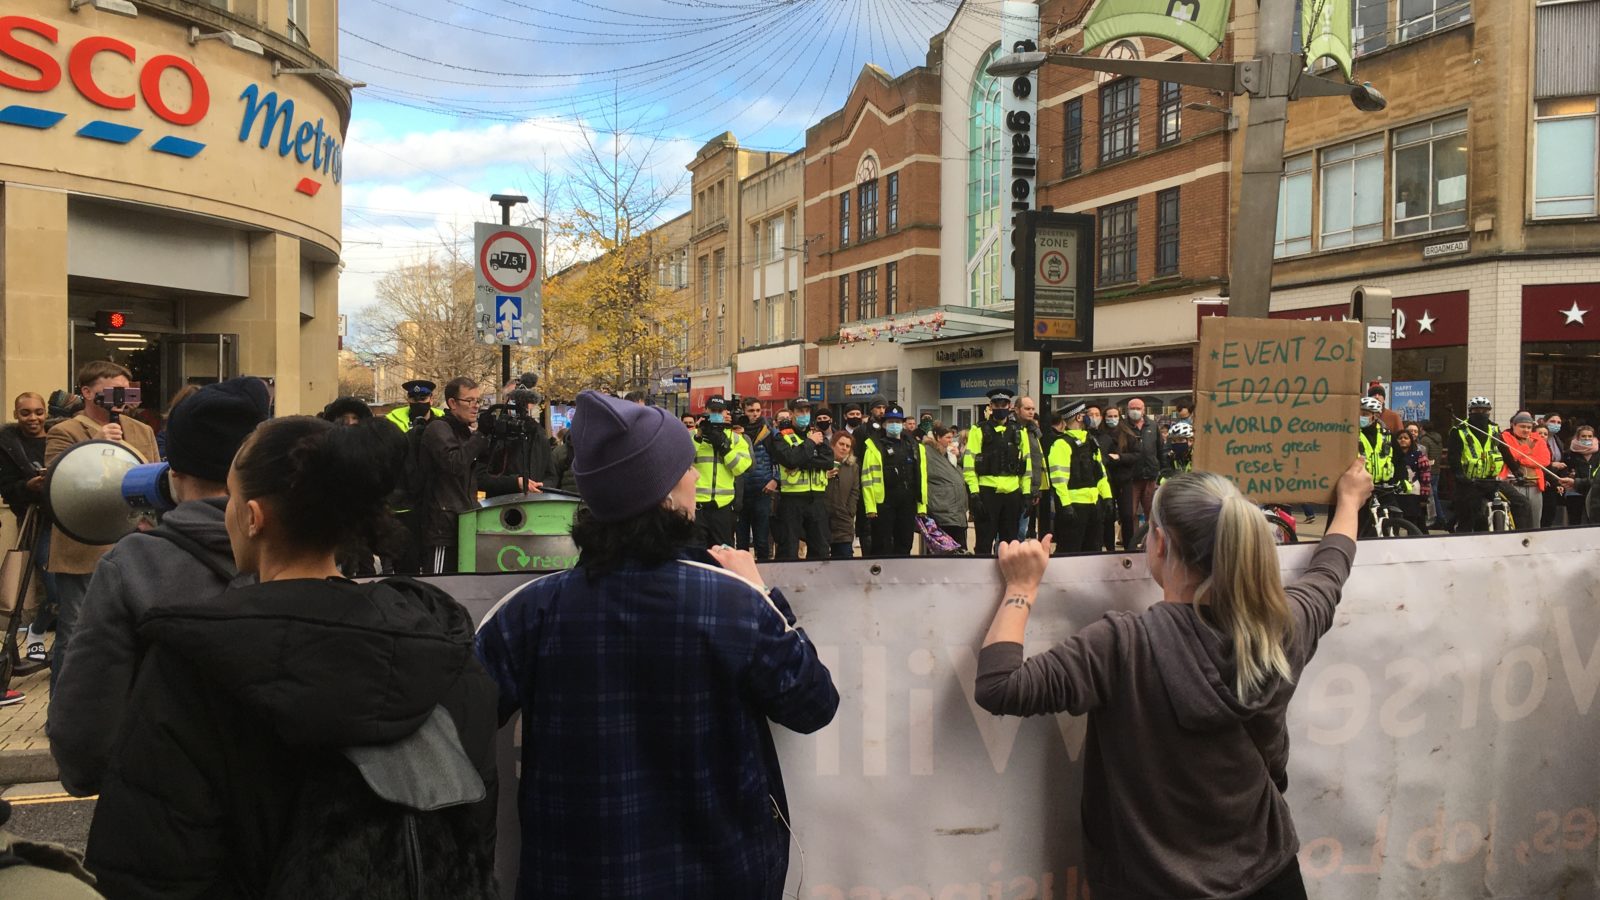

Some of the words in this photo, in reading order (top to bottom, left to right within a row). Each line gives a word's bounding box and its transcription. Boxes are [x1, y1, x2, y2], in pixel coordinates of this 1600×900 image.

[239, 83, 343, 186] Metro
[1036, 230, 1075, 238] EDESTRIAN
[1040, 238, 1068, 248] ZONE
[1426, 242, 1464, 255] BROADMEAD
[1222, 336, 1306, 369] EVENT
[1086, 354, 1154, 380] F.HINDS
[1093, 380, 1119, 389] JEWELLERS
[1120, 379, 1136, 388] SINCE
[1217, 376, 1329, 409] ID2020
[1214, 416, 1283, 435] WORLD
[1287, 416, 1355, 435] economic
[1225, 440, 1273, 455] forums
[1282, 440, 1321, 458] great
[1235, 459, 1285, 474] reset
